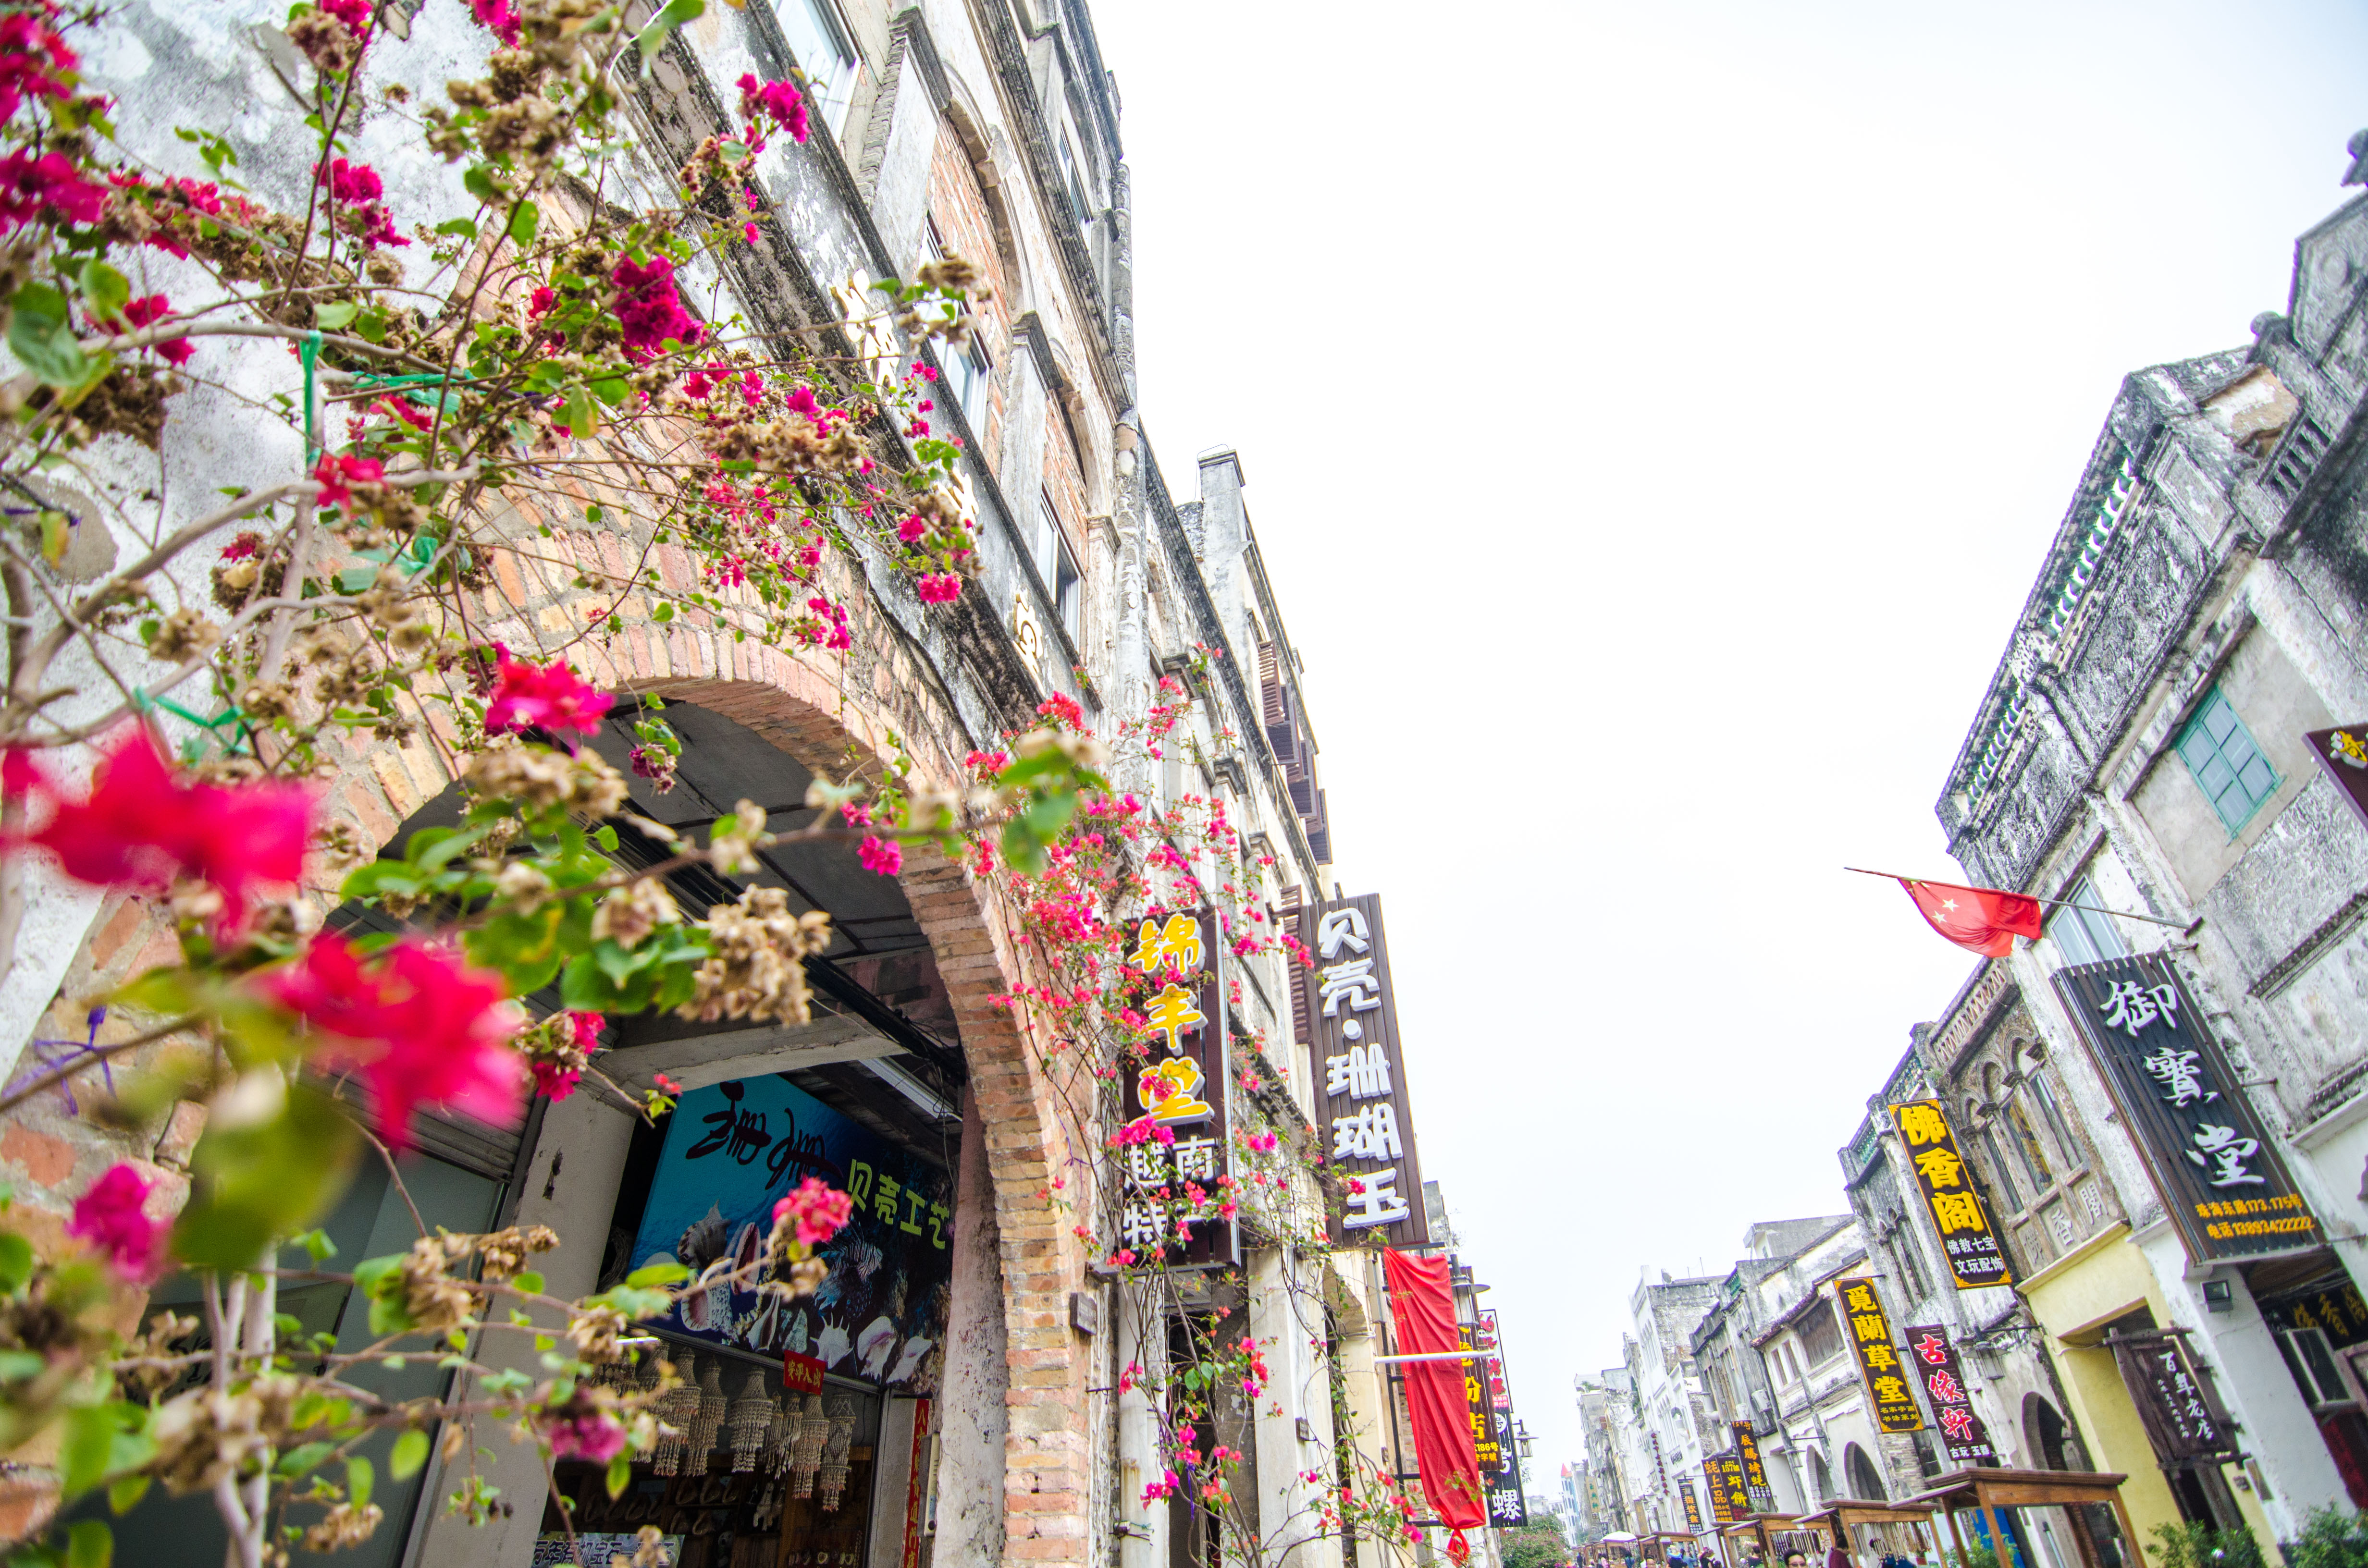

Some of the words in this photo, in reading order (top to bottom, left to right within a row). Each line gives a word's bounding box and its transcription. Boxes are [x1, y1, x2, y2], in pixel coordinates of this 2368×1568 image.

[1123, 1135, 1215, 1189] 越南
[1900, 1105, 1985, 1235] 佛香阁
[847, 1158, 950, 1250] 贝壳工艺
[1947, 1235, 1998, 1255] 佛教七宝
[1954, 1255, 2005, 1275] 文玩配饰
[1949, 1446, 1969, 1458] 古玩
